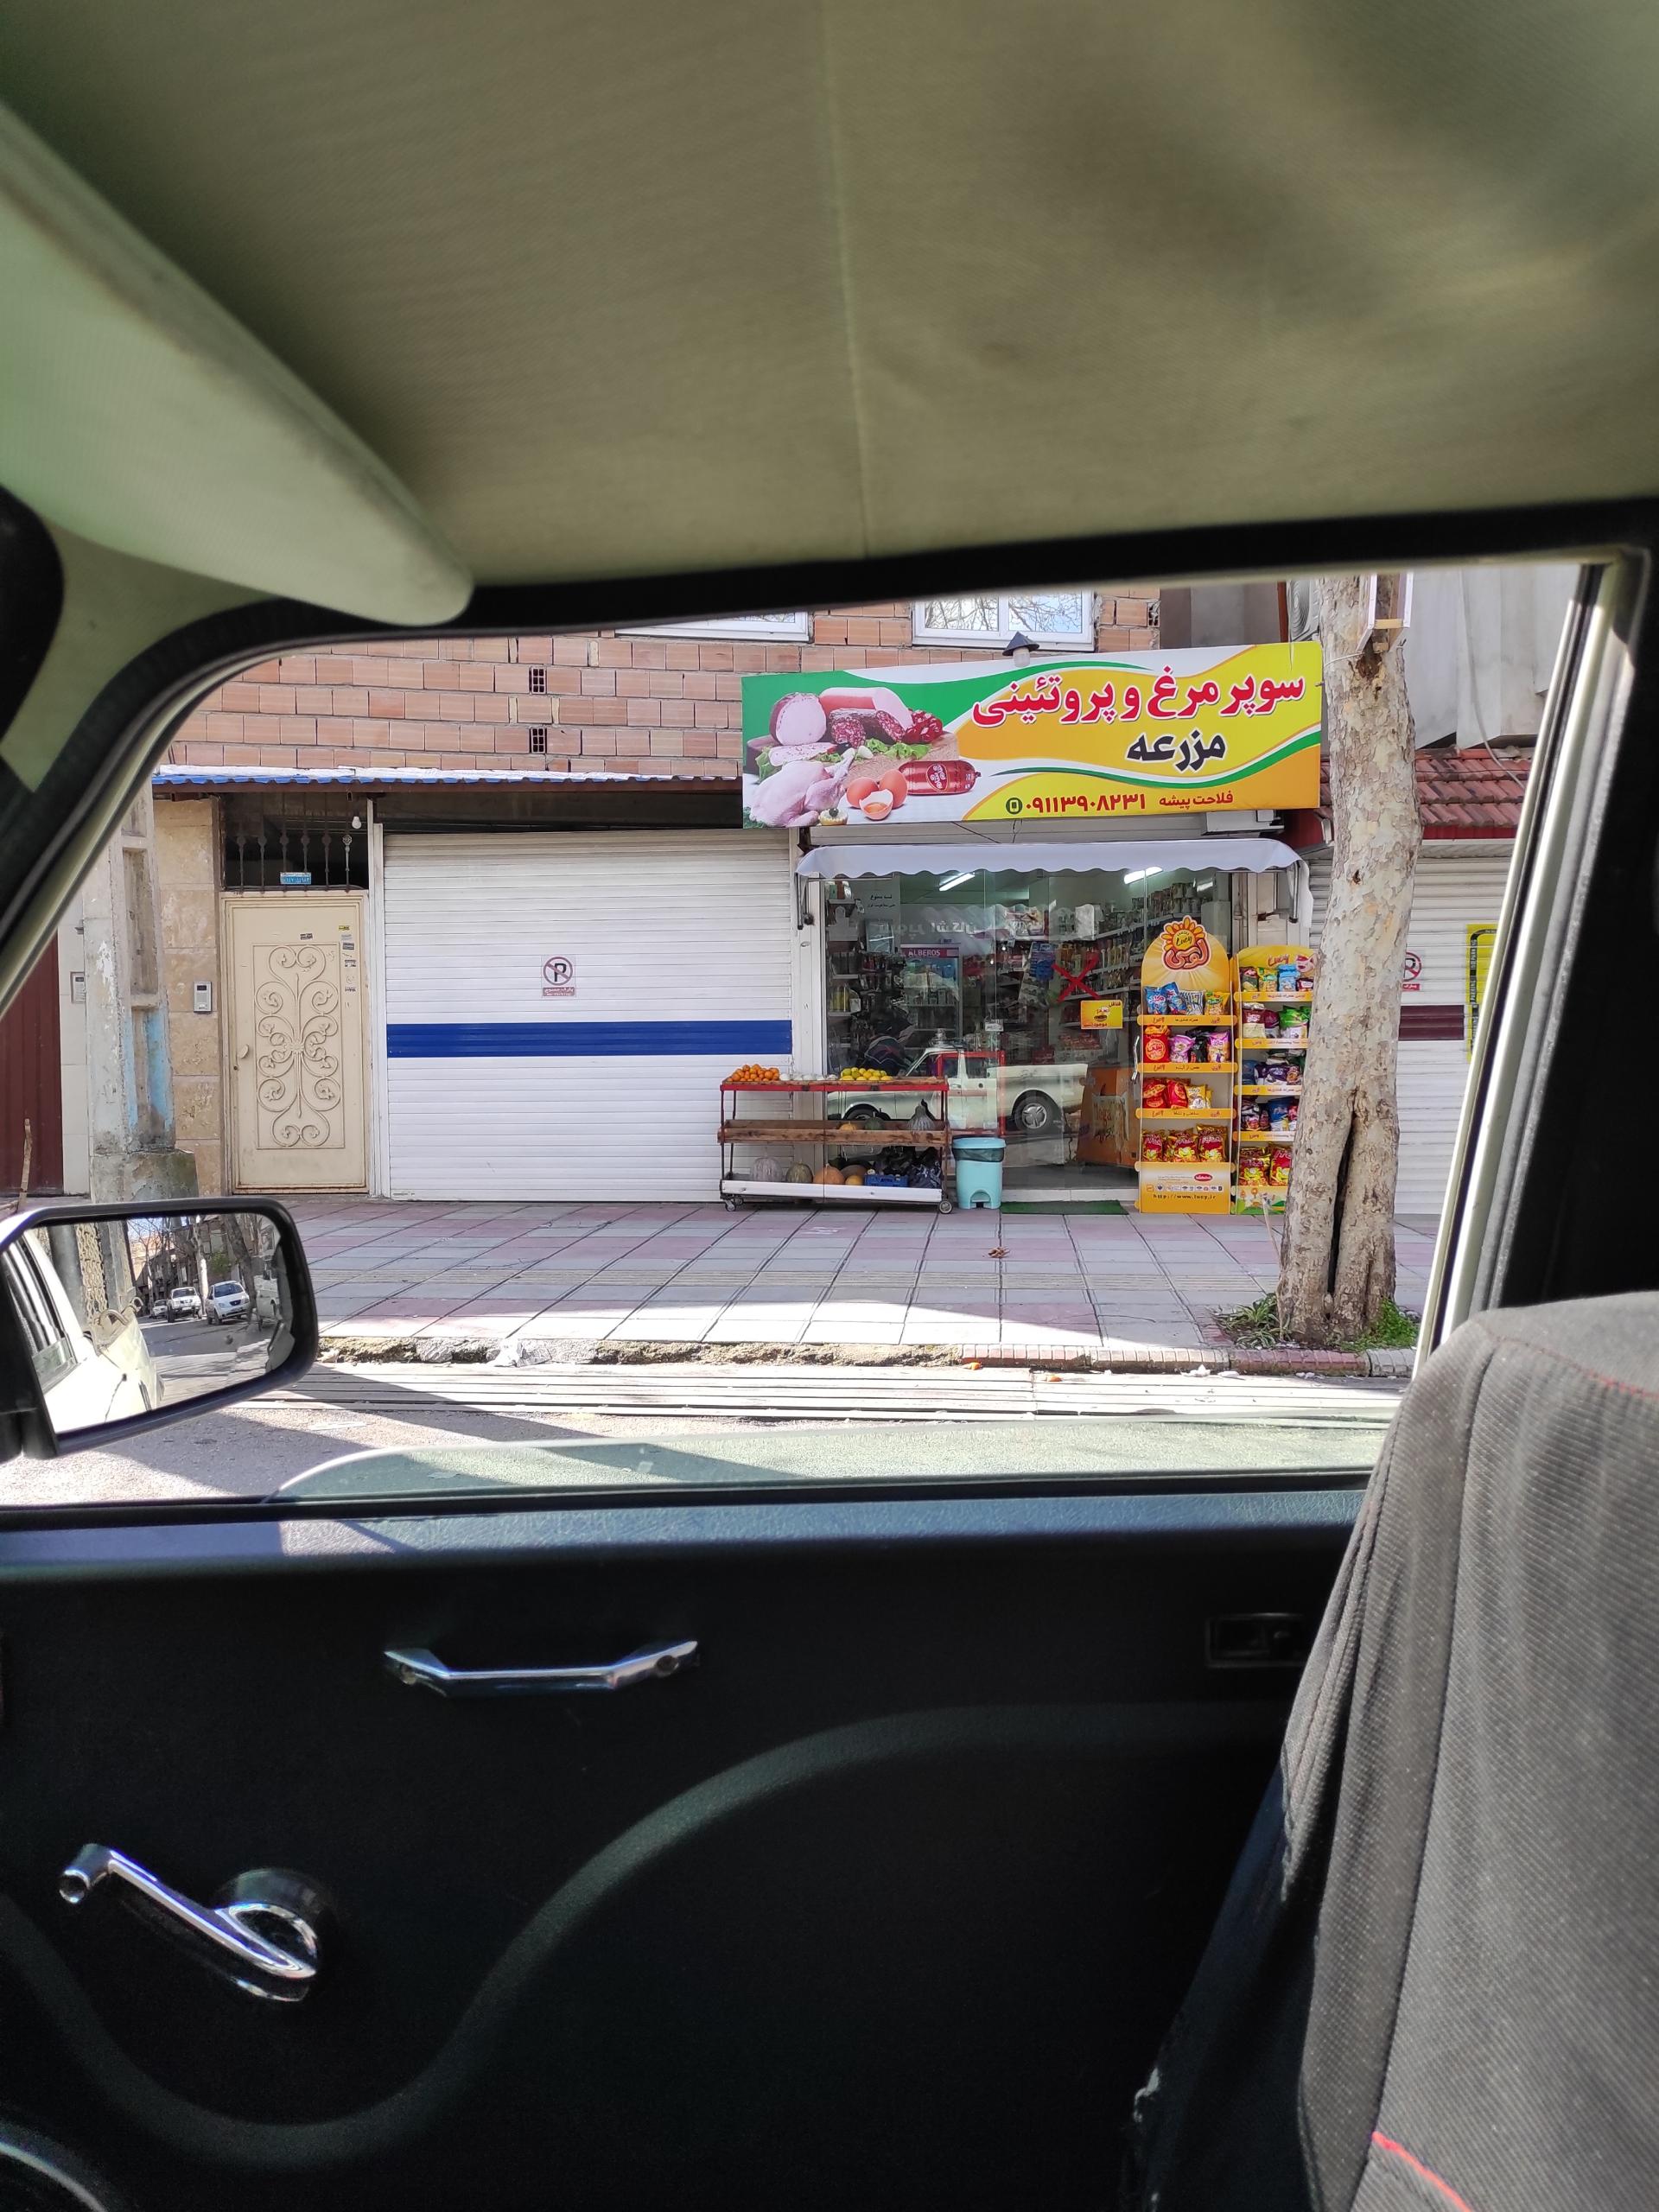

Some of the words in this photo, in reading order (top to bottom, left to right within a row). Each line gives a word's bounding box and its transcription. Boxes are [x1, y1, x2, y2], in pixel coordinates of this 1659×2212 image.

[973, 676, 1116, 726] پروتئینی
[1122, 686, 1141, 719] و
[1148, 665, 1219, 718] مرغ
[1221, 674, 1305, 715] سوپر
[1127, 729, 1226, 772] مزرعه
[1026, 793, 1146, 813] ۰۹۱۱۳۹۰۸۲۳۱
[1159, 795, 1191, 810] پیشه
[1192, 790, 1234, 805] فلاحت
